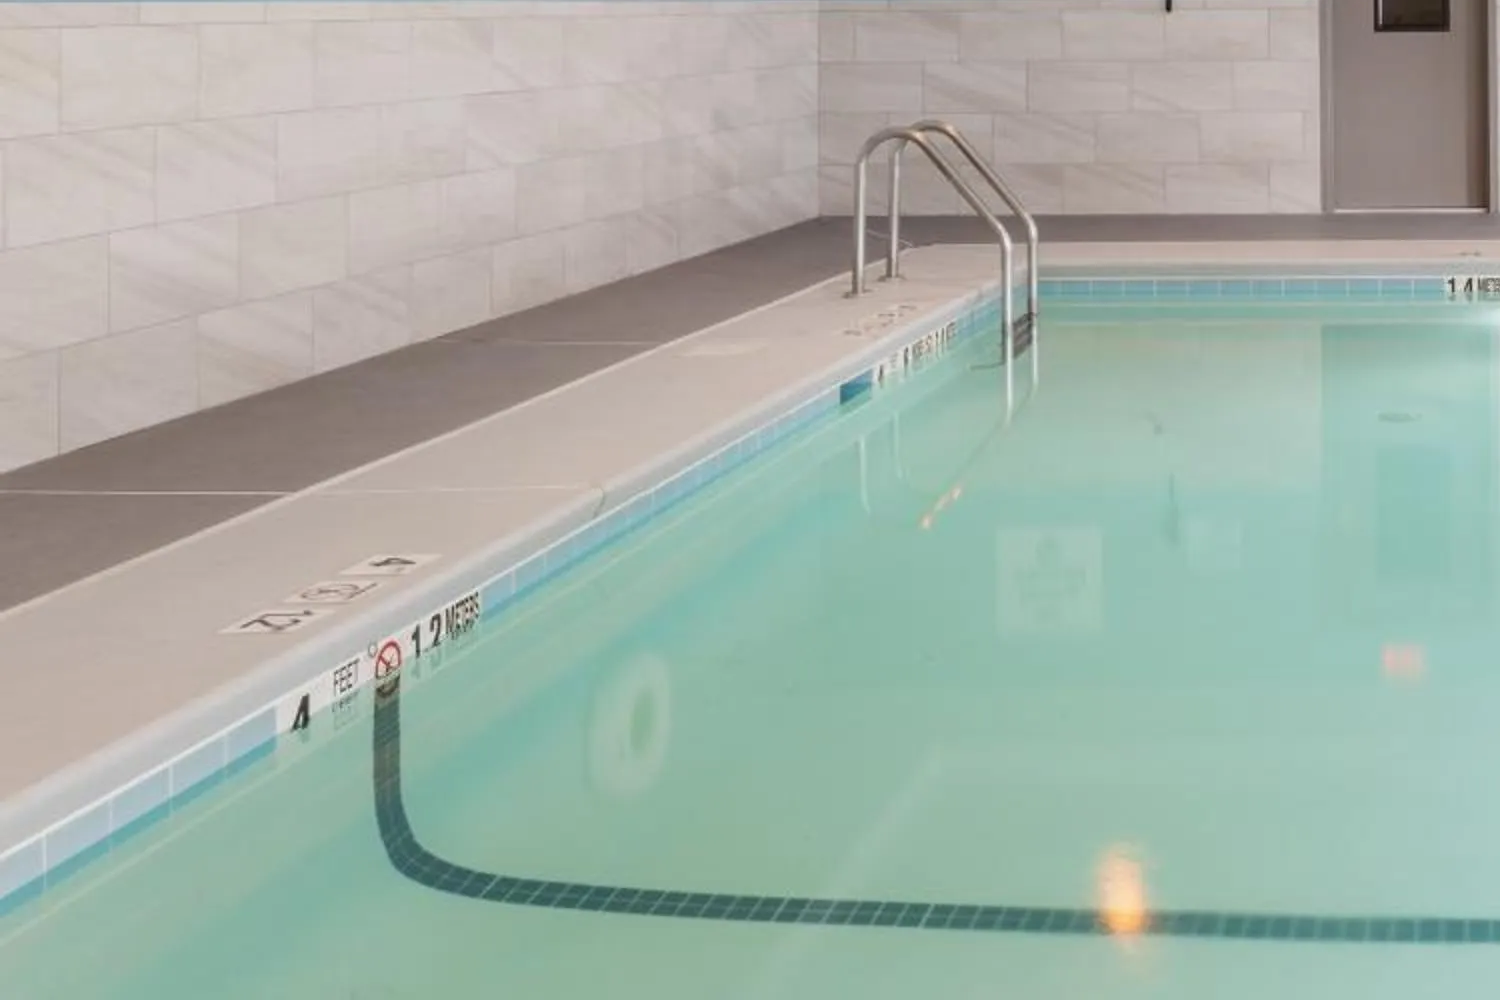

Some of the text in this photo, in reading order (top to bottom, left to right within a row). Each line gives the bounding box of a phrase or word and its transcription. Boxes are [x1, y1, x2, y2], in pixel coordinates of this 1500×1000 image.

[291, 694, 310, 731] 4
[333, 658, 360, 697] FEET
[446, 591, 479, 637] METERS
